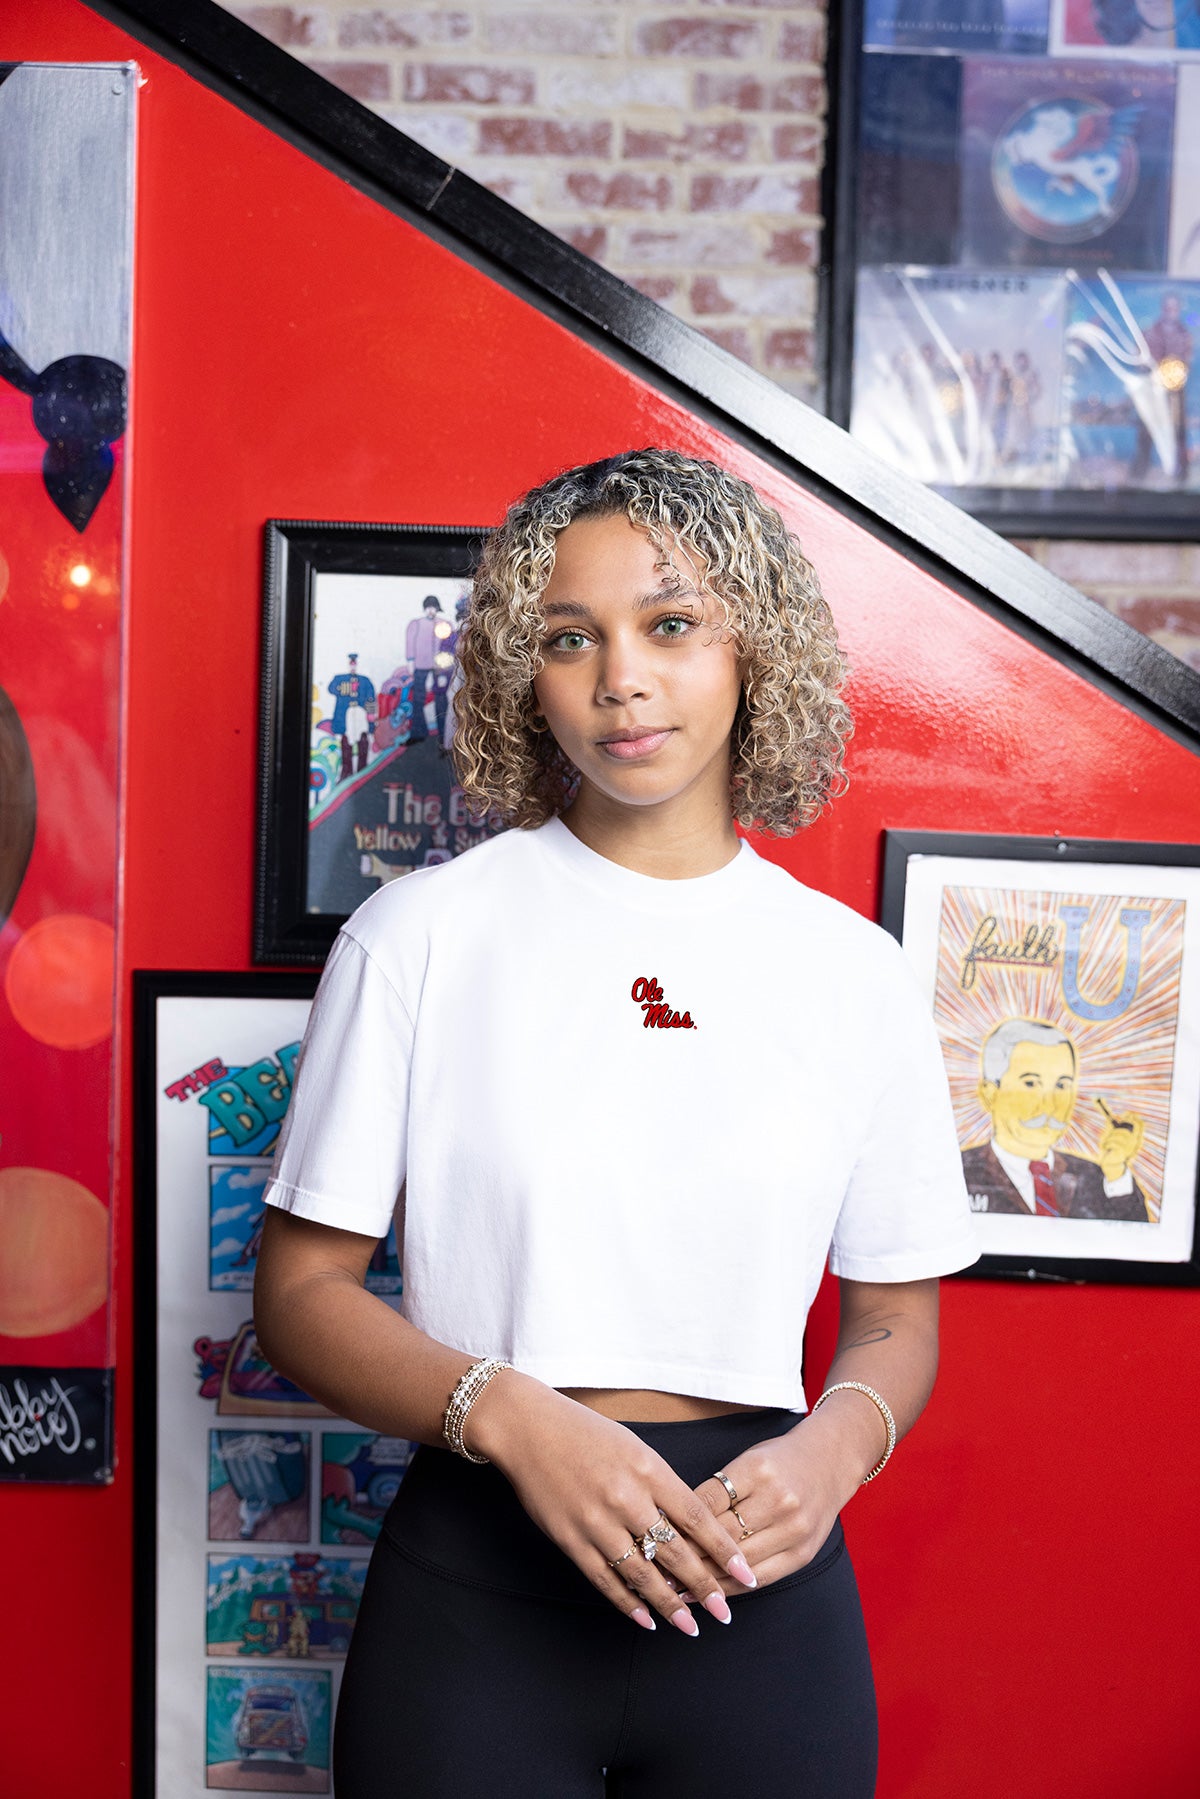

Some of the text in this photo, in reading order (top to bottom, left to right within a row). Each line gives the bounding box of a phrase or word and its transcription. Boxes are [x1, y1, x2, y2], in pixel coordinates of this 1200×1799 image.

[382, 782, 442, 825] The
[353, 823, 422, 851] Yellow
[631, 977, 664, 1003] Ole
[164, 1057, 228, 1102] THE
